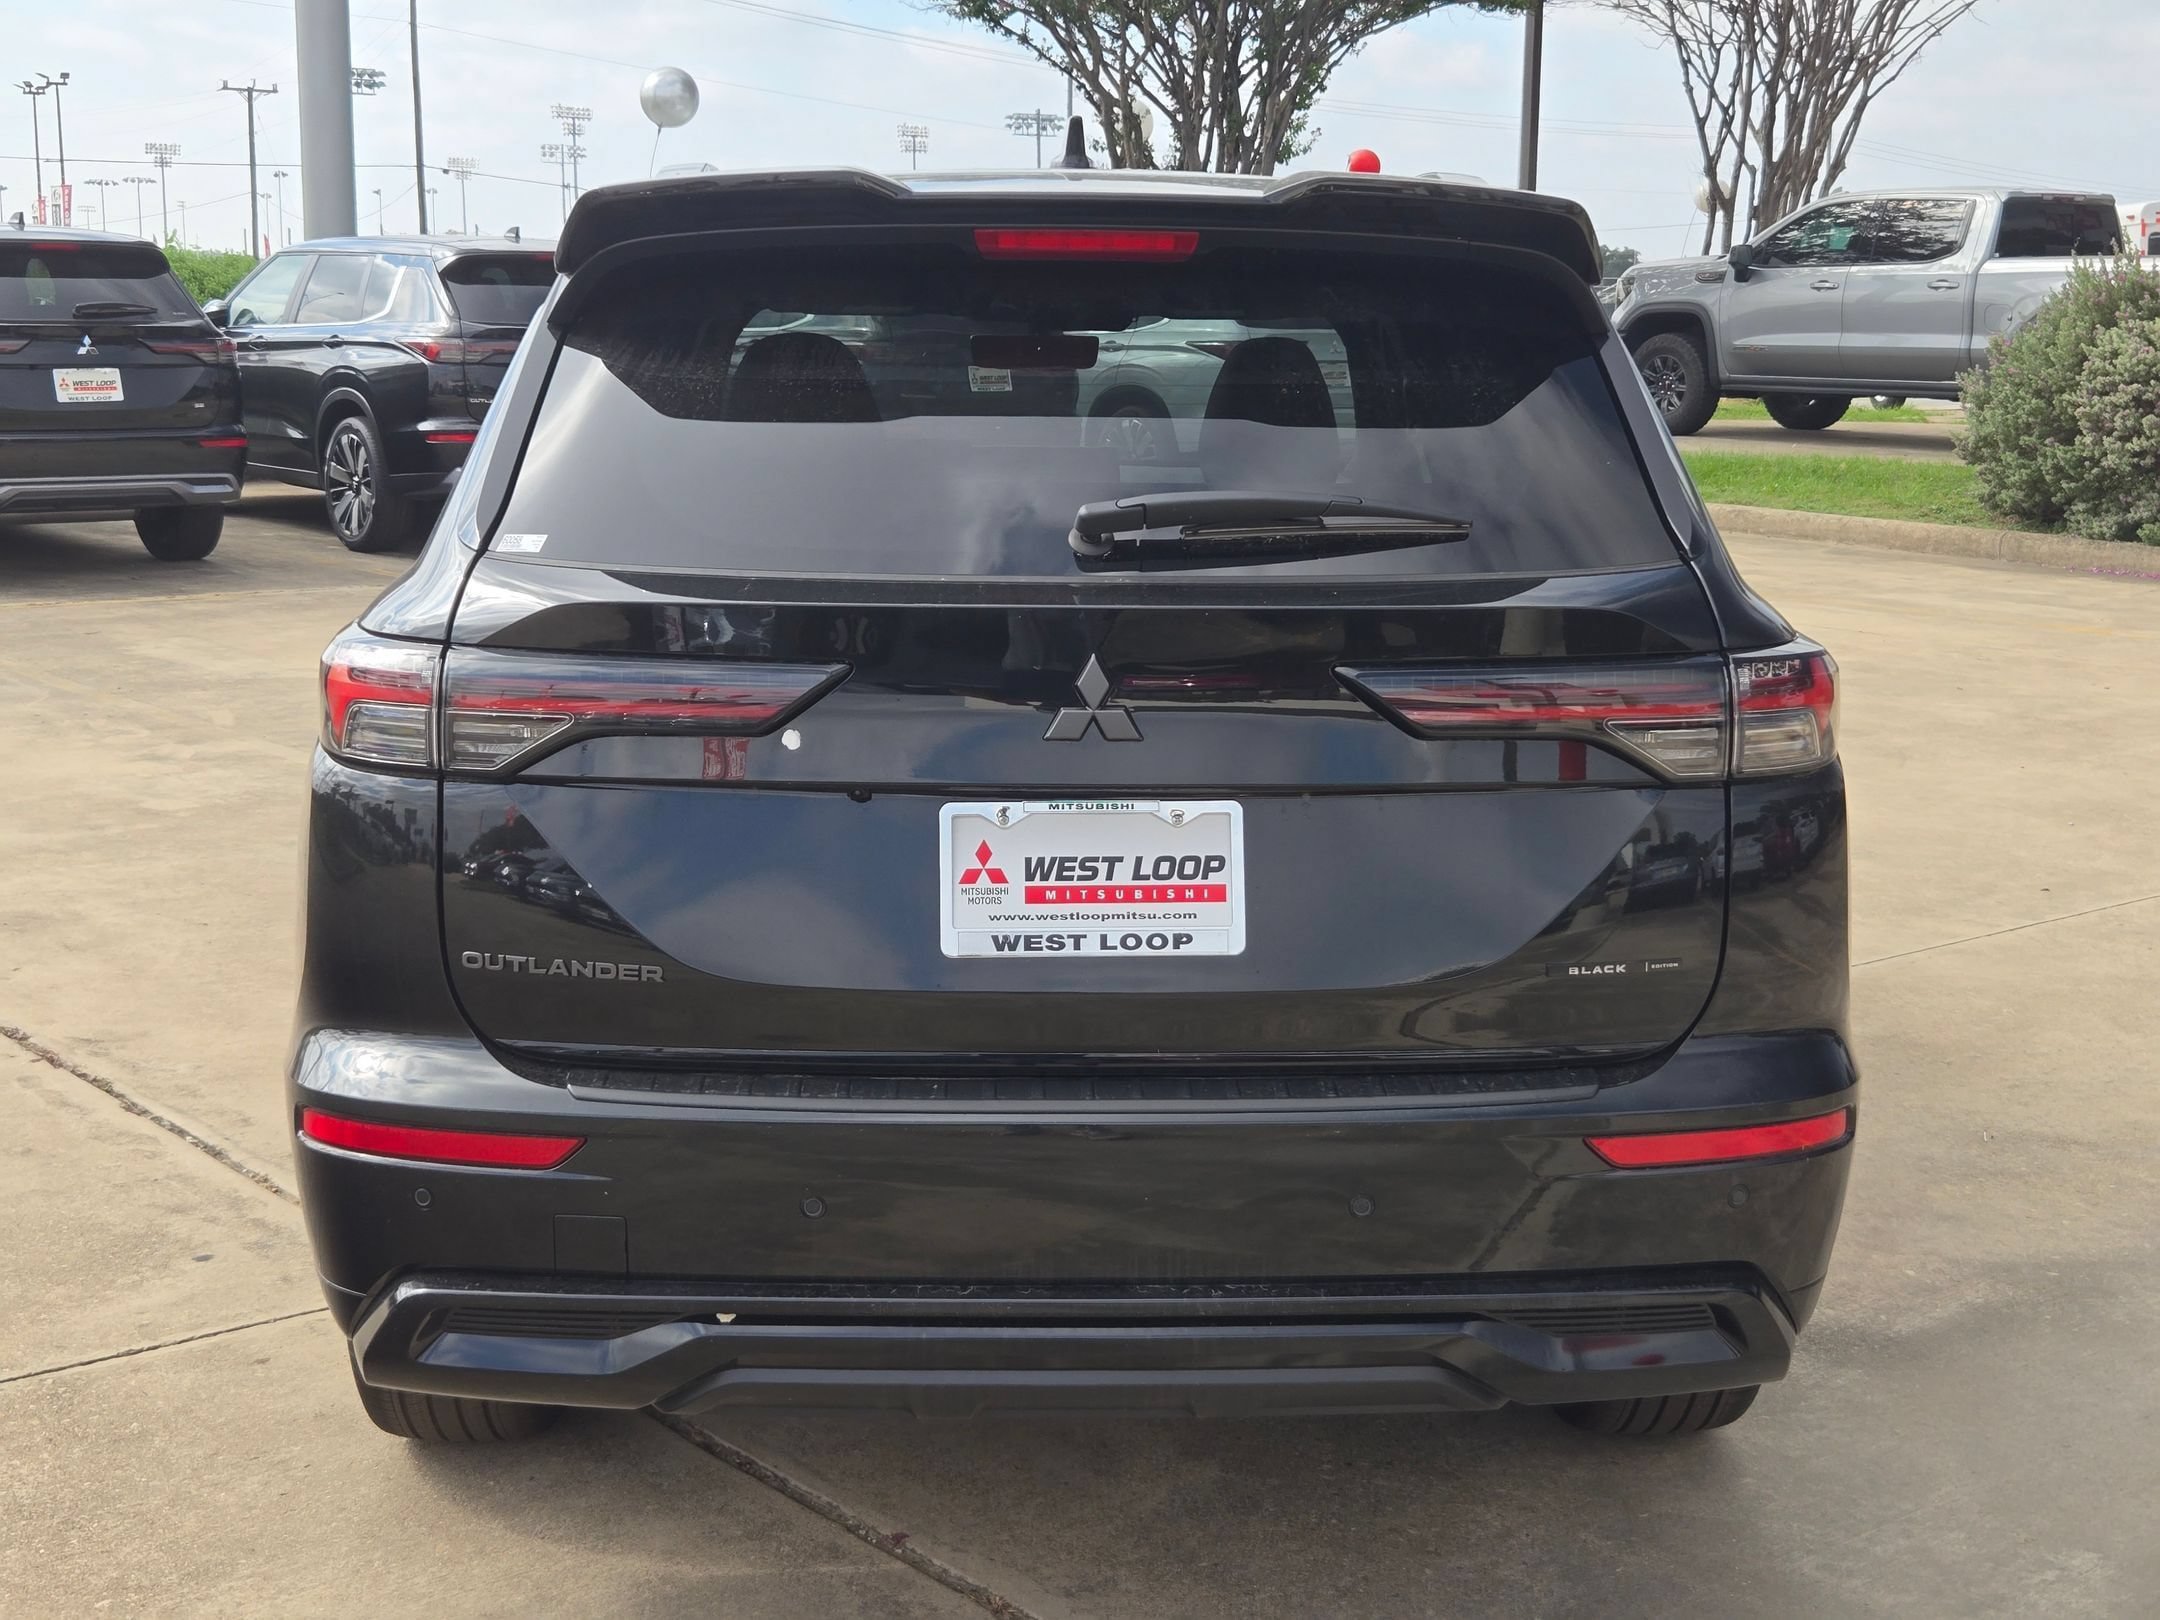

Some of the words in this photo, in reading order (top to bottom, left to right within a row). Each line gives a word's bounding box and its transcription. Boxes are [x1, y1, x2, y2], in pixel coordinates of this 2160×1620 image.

[1024, 856, 1124, 882] WEST
[1131, 855, 1226, 881] LOOP
[961, 887, 1009, 896] MITSUBISHI
[1045, 889, 1209, 900] MITSUBISHI
[967, 896, 1002, 905] MOTORS
[988, 911, 1198, 922] www.westloopmitsu.com
[991, 933, 1087, 952] WEST
[1099, 932, 1194, 951] LOOP
[461, 951, 664, 983] OUTLANDER
[1568, 963, 1627, 975] BLACK
